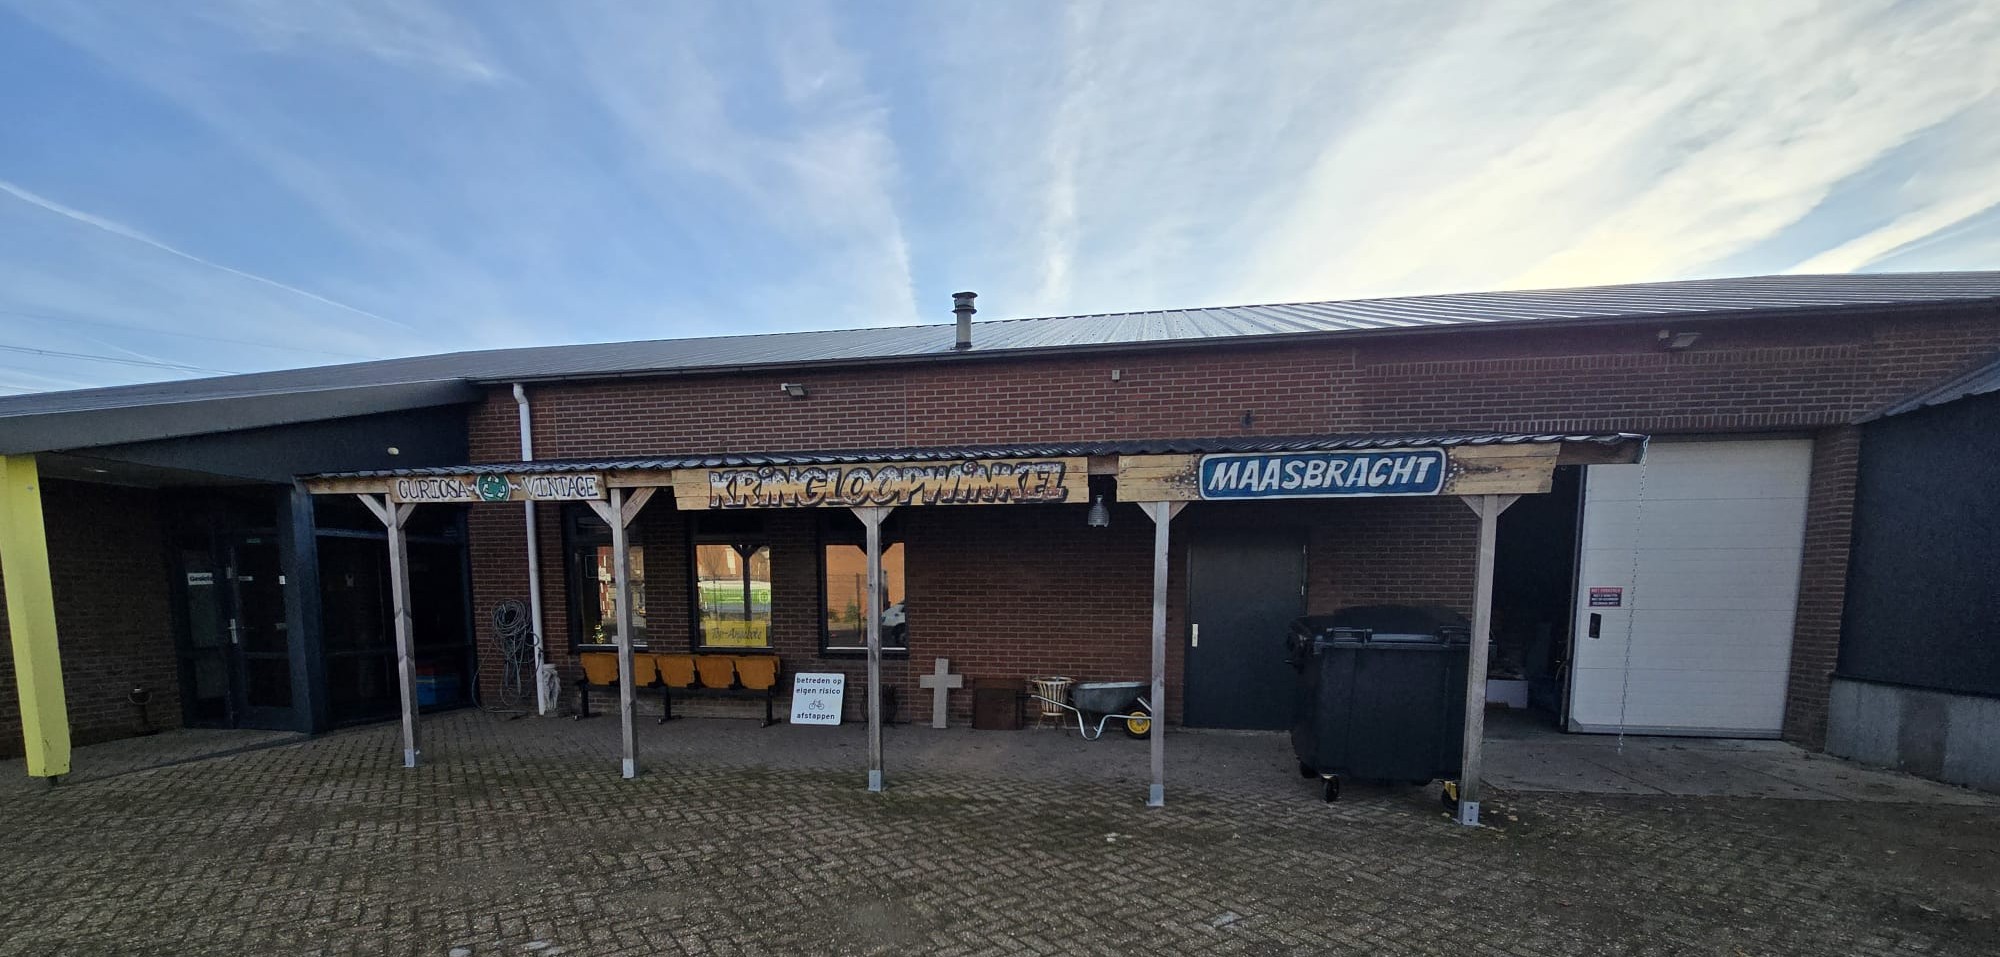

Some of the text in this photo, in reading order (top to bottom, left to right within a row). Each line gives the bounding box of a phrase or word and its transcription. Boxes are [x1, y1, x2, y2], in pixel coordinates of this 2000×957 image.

[1208, 455, 1436, 491] MAASBRACHT
[397, 476, 598, 500] CURIOSA VINTAGE
[796, 712, 835, 720] afstappen
